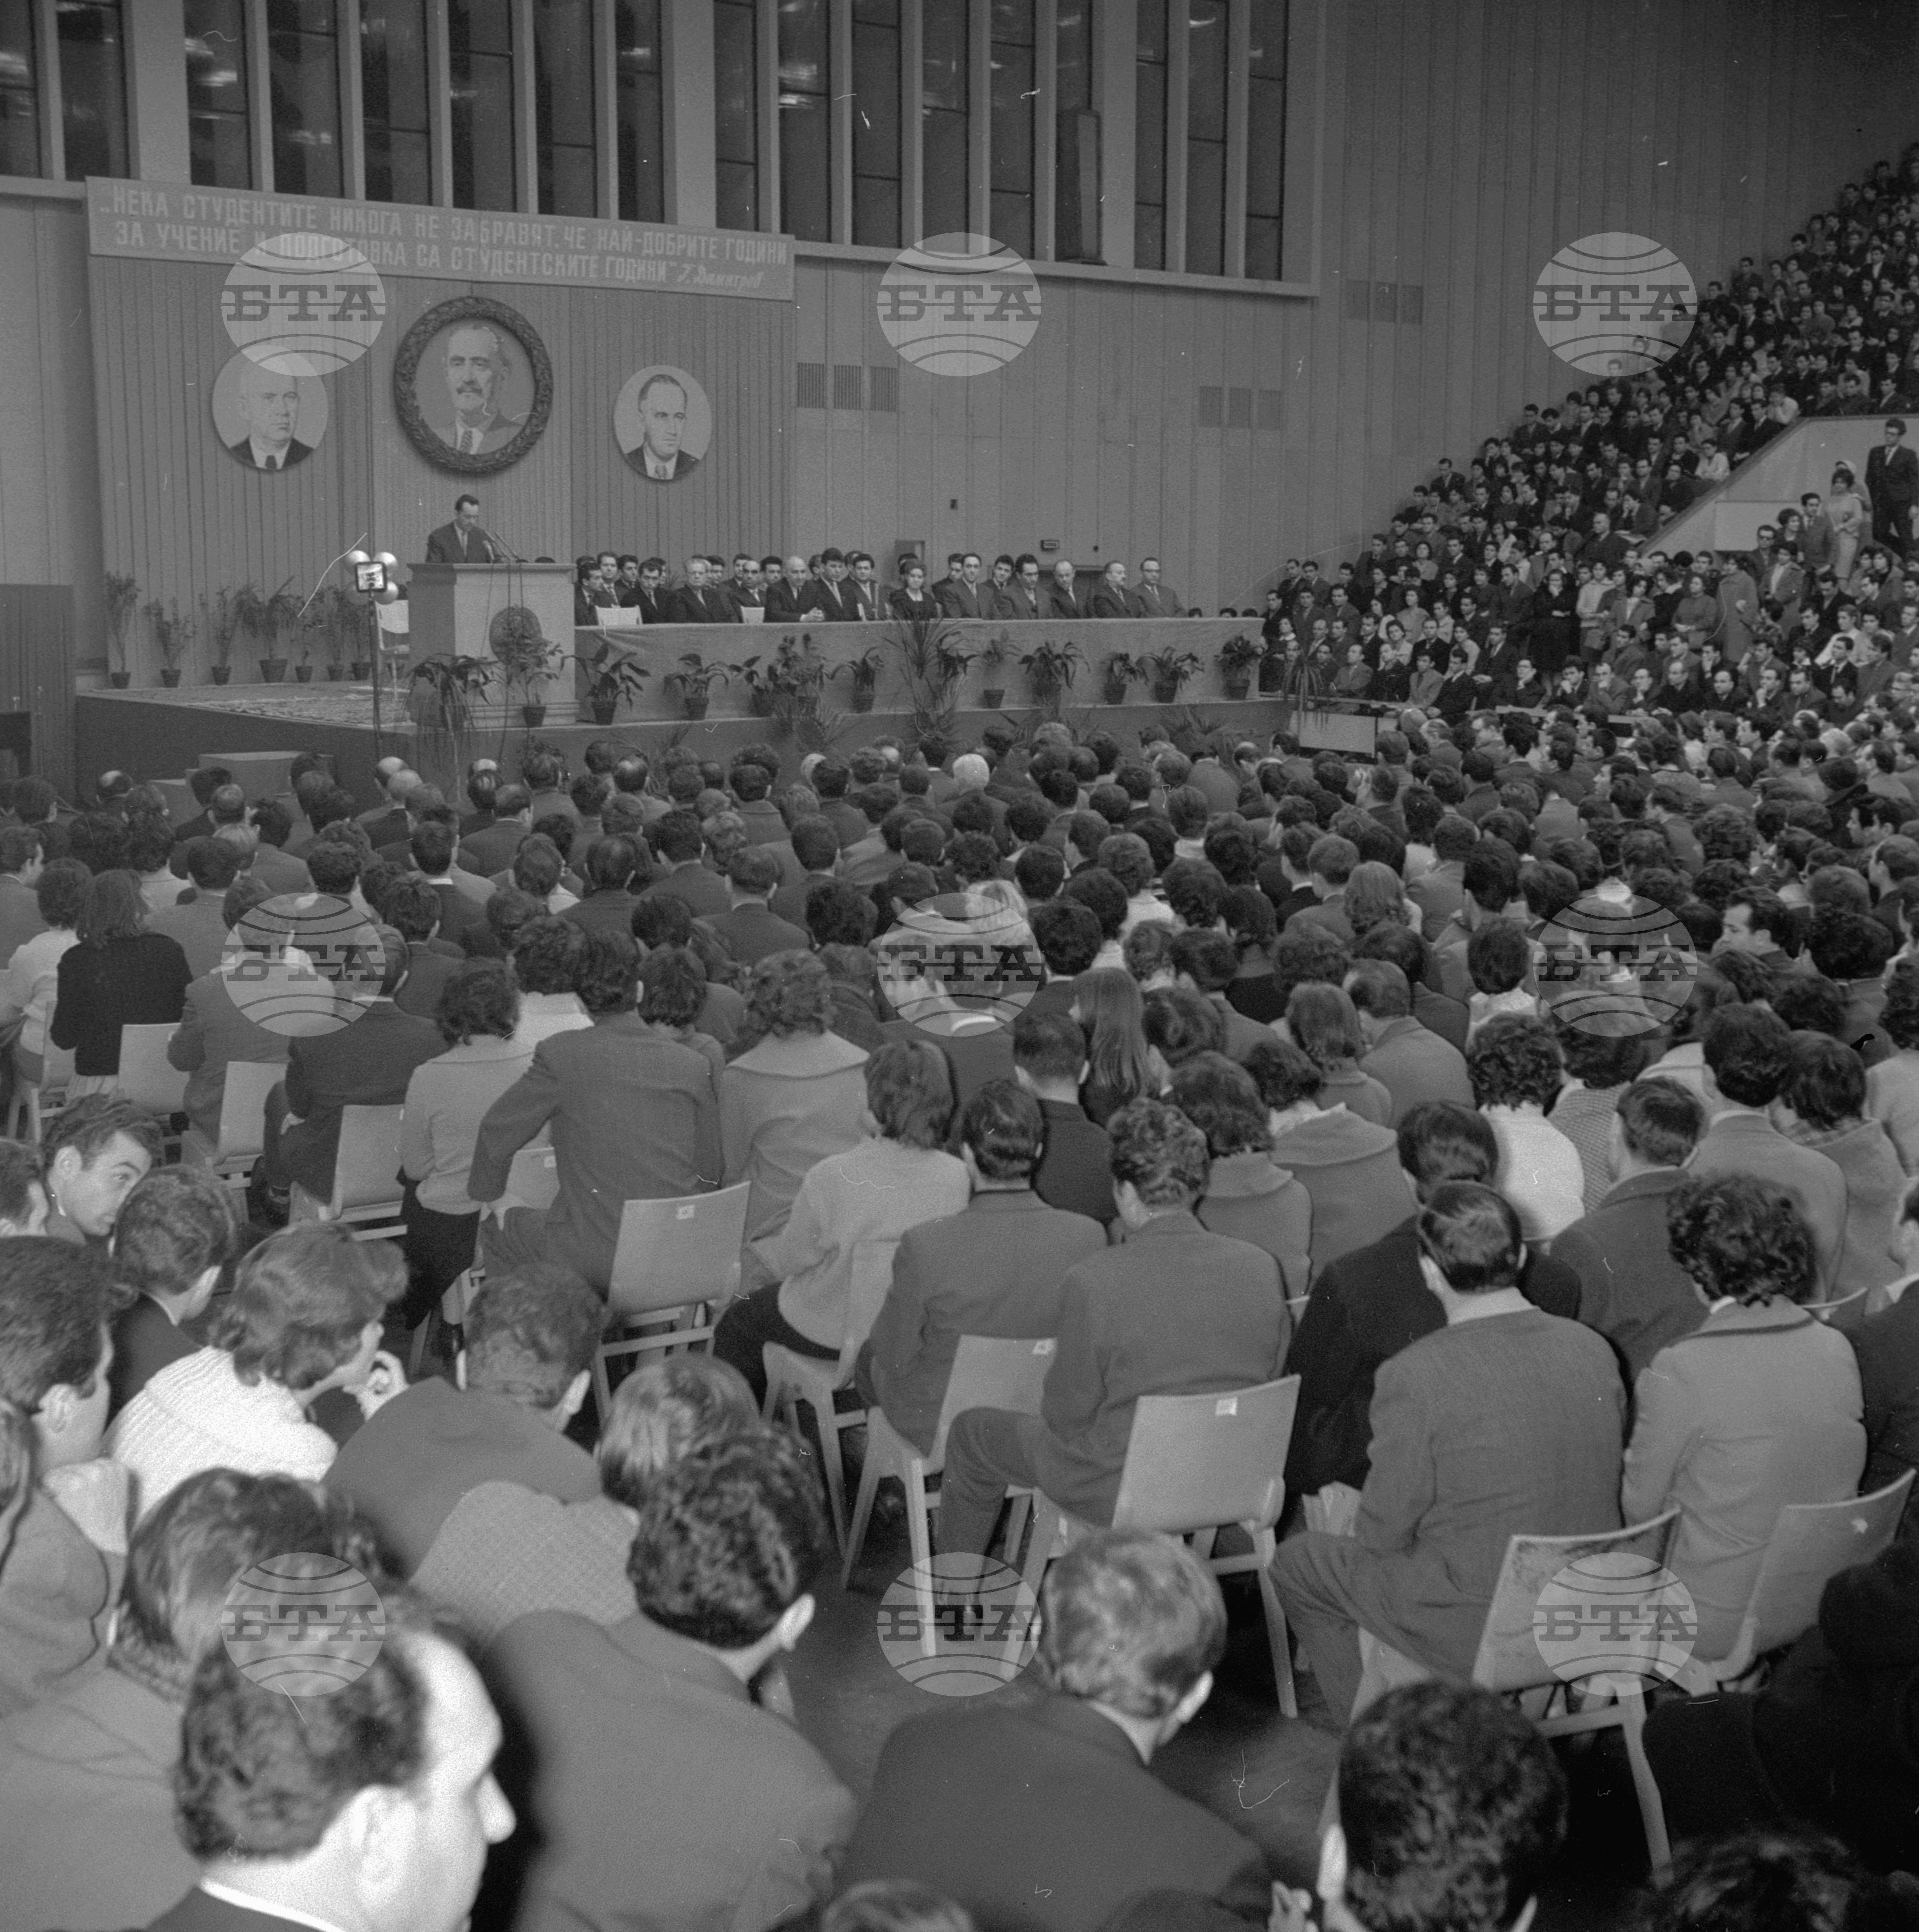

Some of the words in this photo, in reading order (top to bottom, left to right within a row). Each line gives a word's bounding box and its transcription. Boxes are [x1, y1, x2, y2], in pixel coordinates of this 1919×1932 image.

[115, 220, 144, 247] ЗА
[156, 222, 240, 254] УЧЕНИЕ
[254, 231, 266, 255] И
[280, 234, 408, 267] ПОДГОТОВКА
[417, 244, 440, 268] СА
[452, 247, 598, 278] СТУДЕНТСКИТЕ
[184, 194, 317, 229] СТУДЕНТИТЕ
[330, 206, 402, 235] НИКОГА
[415, 213, 439, 239] НЕ
[564, 225, 586, 249] ЧЕ
[597, 225, 719, 260] НАЙ-ДОБРИТЕ
[726, 238, 787, 265] ГОДИНИ
